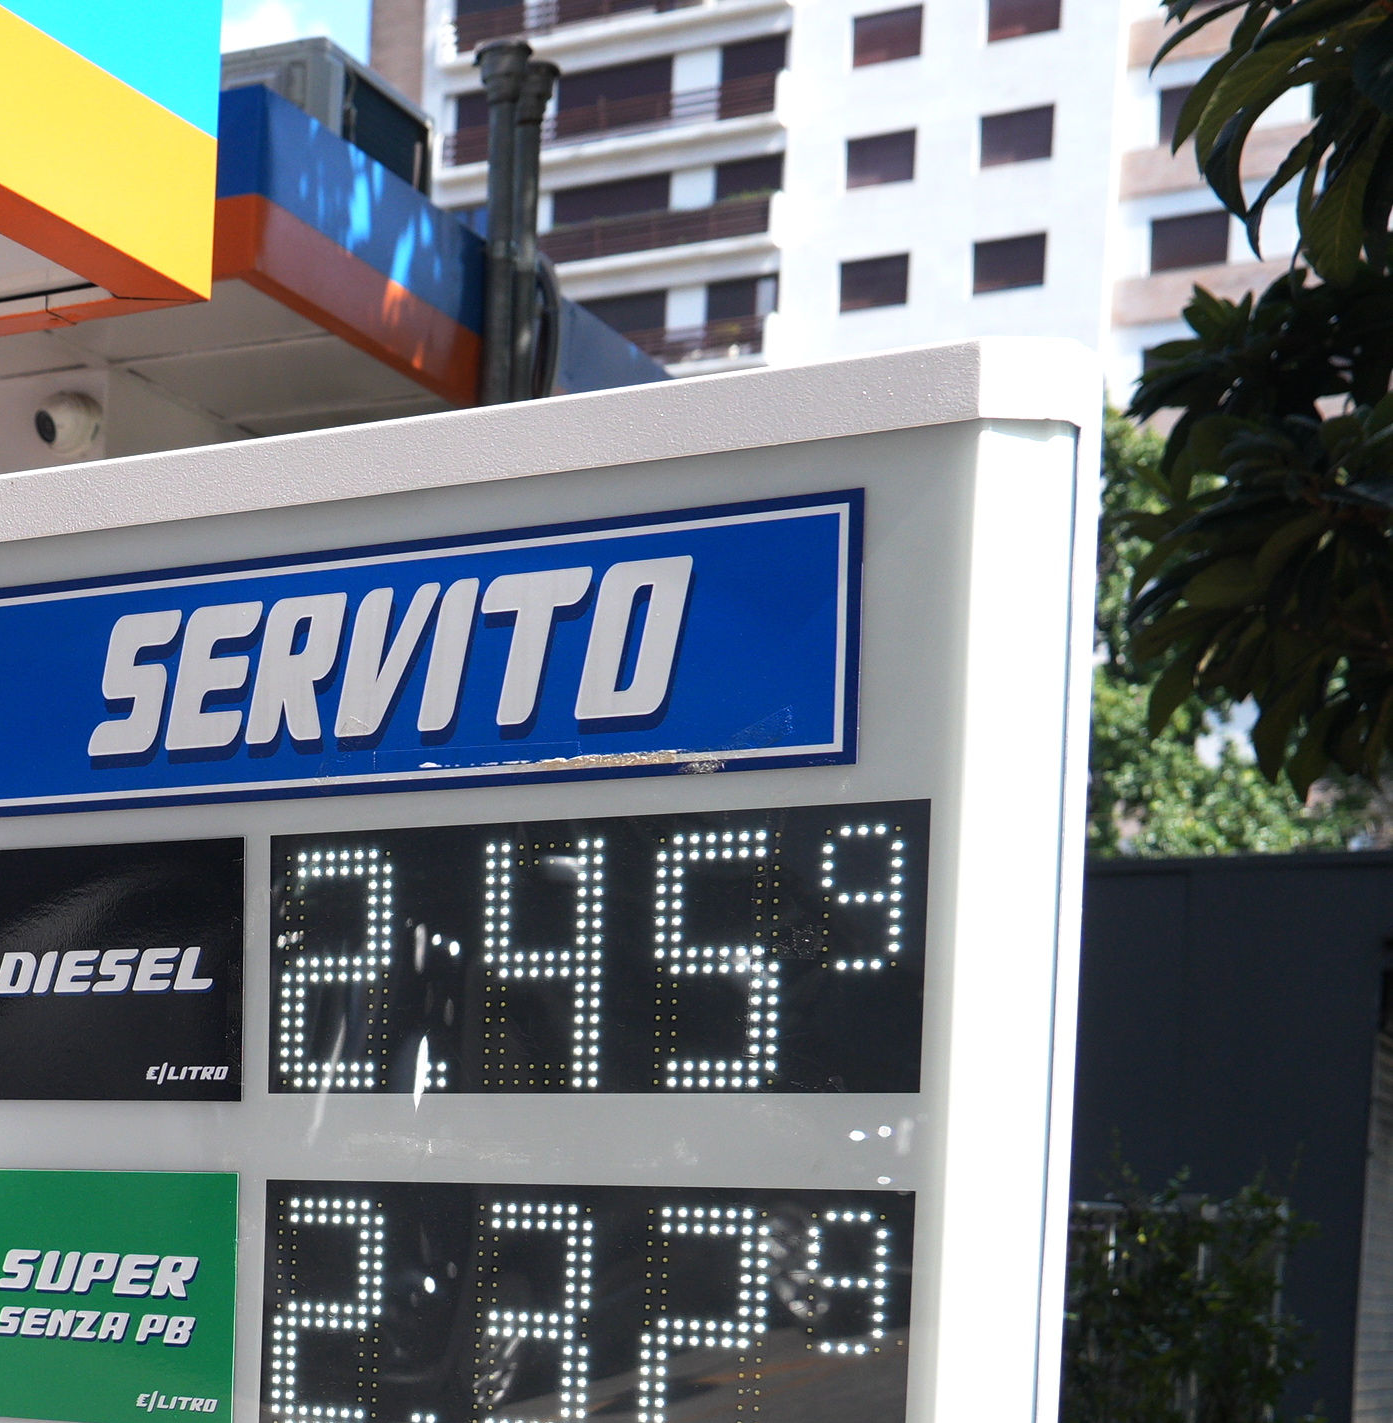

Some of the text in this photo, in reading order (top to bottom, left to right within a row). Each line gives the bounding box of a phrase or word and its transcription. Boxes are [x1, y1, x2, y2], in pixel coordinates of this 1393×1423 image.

[87, 554, 699, 760] SERVITO
[145, 1061, 229, 1085] €/LITRO
[134, 1313, 197, 1348] PB
[135, 1390, 219, 1413] €/LITRO
